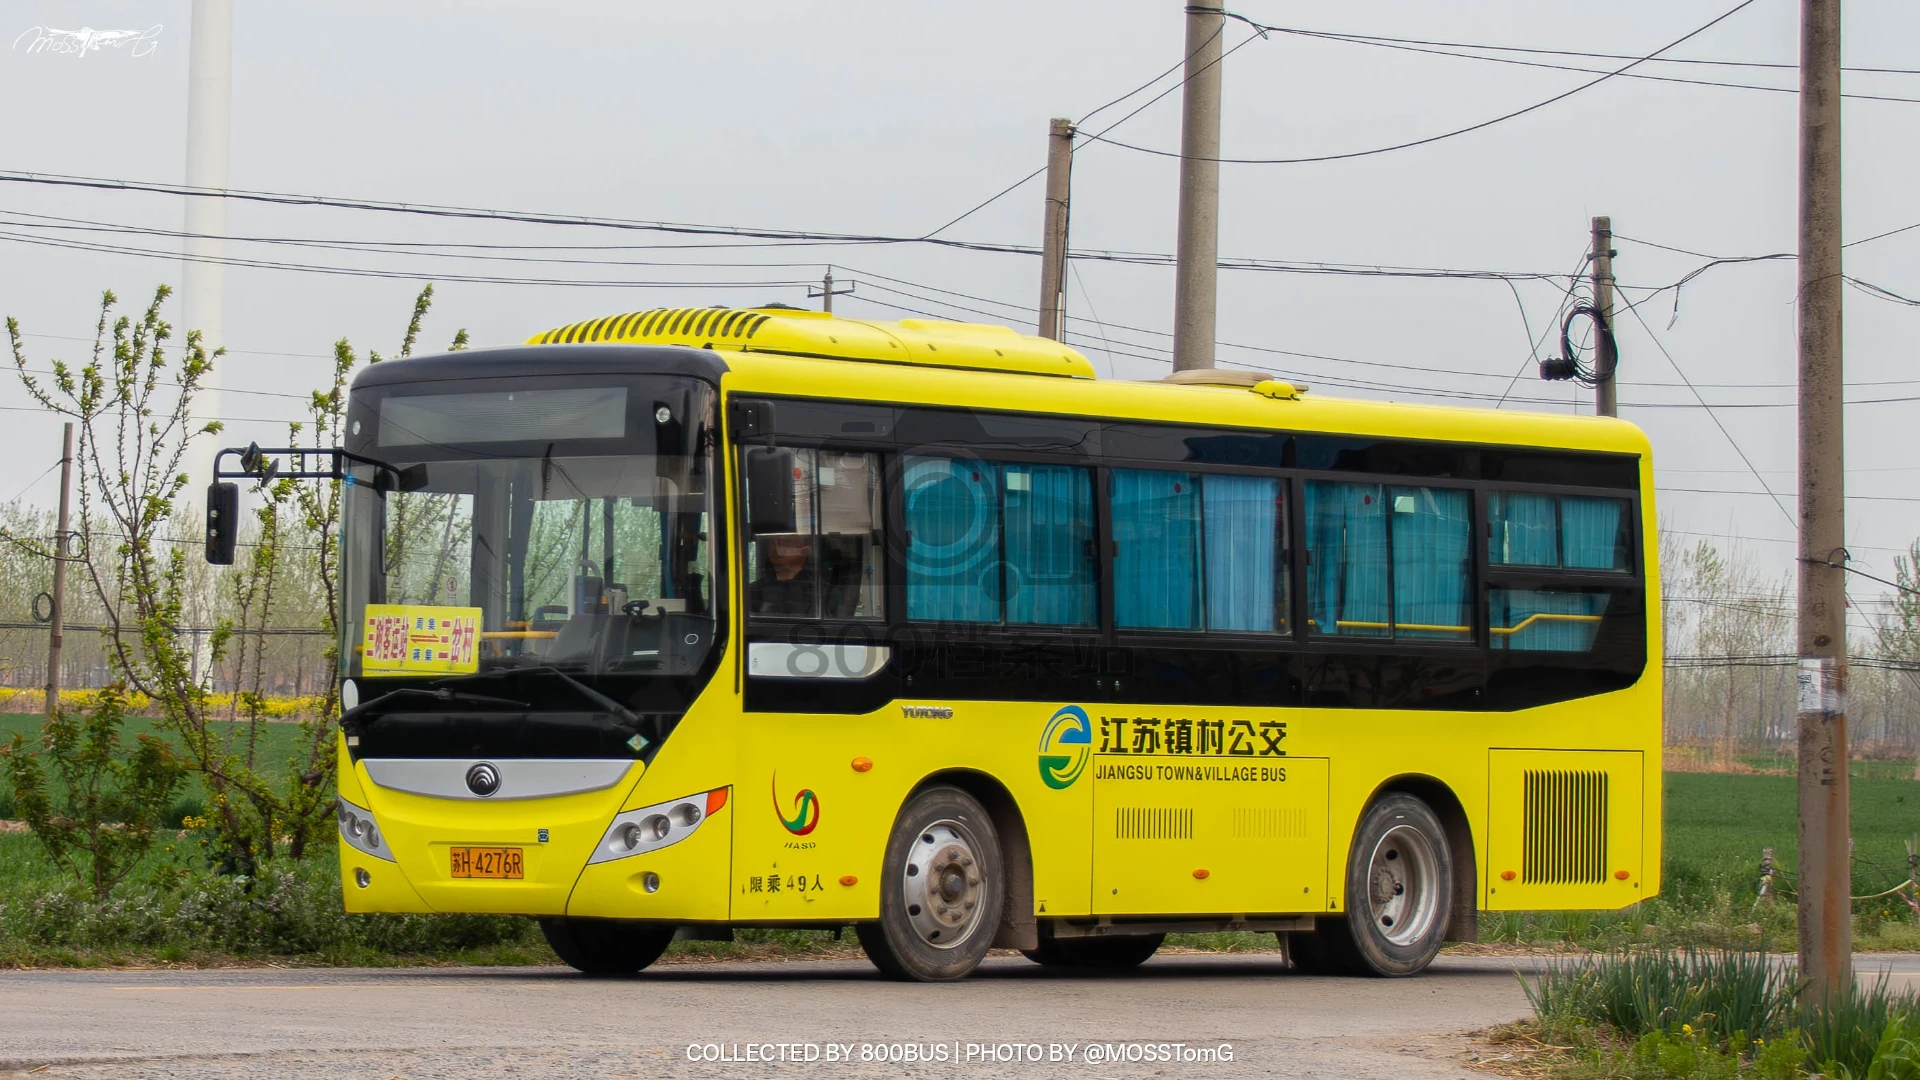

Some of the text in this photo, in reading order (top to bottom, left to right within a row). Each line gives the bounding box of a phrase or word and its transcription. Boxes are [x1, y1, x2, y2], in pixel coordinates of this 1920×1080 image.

[900, 705, 954, 719] YUTONG
[1099, 716, 1288, 756] 江苏镇村公交
[1095, 764, 1288, 783] JIANGSU TOWN&VILLAGE BUS
